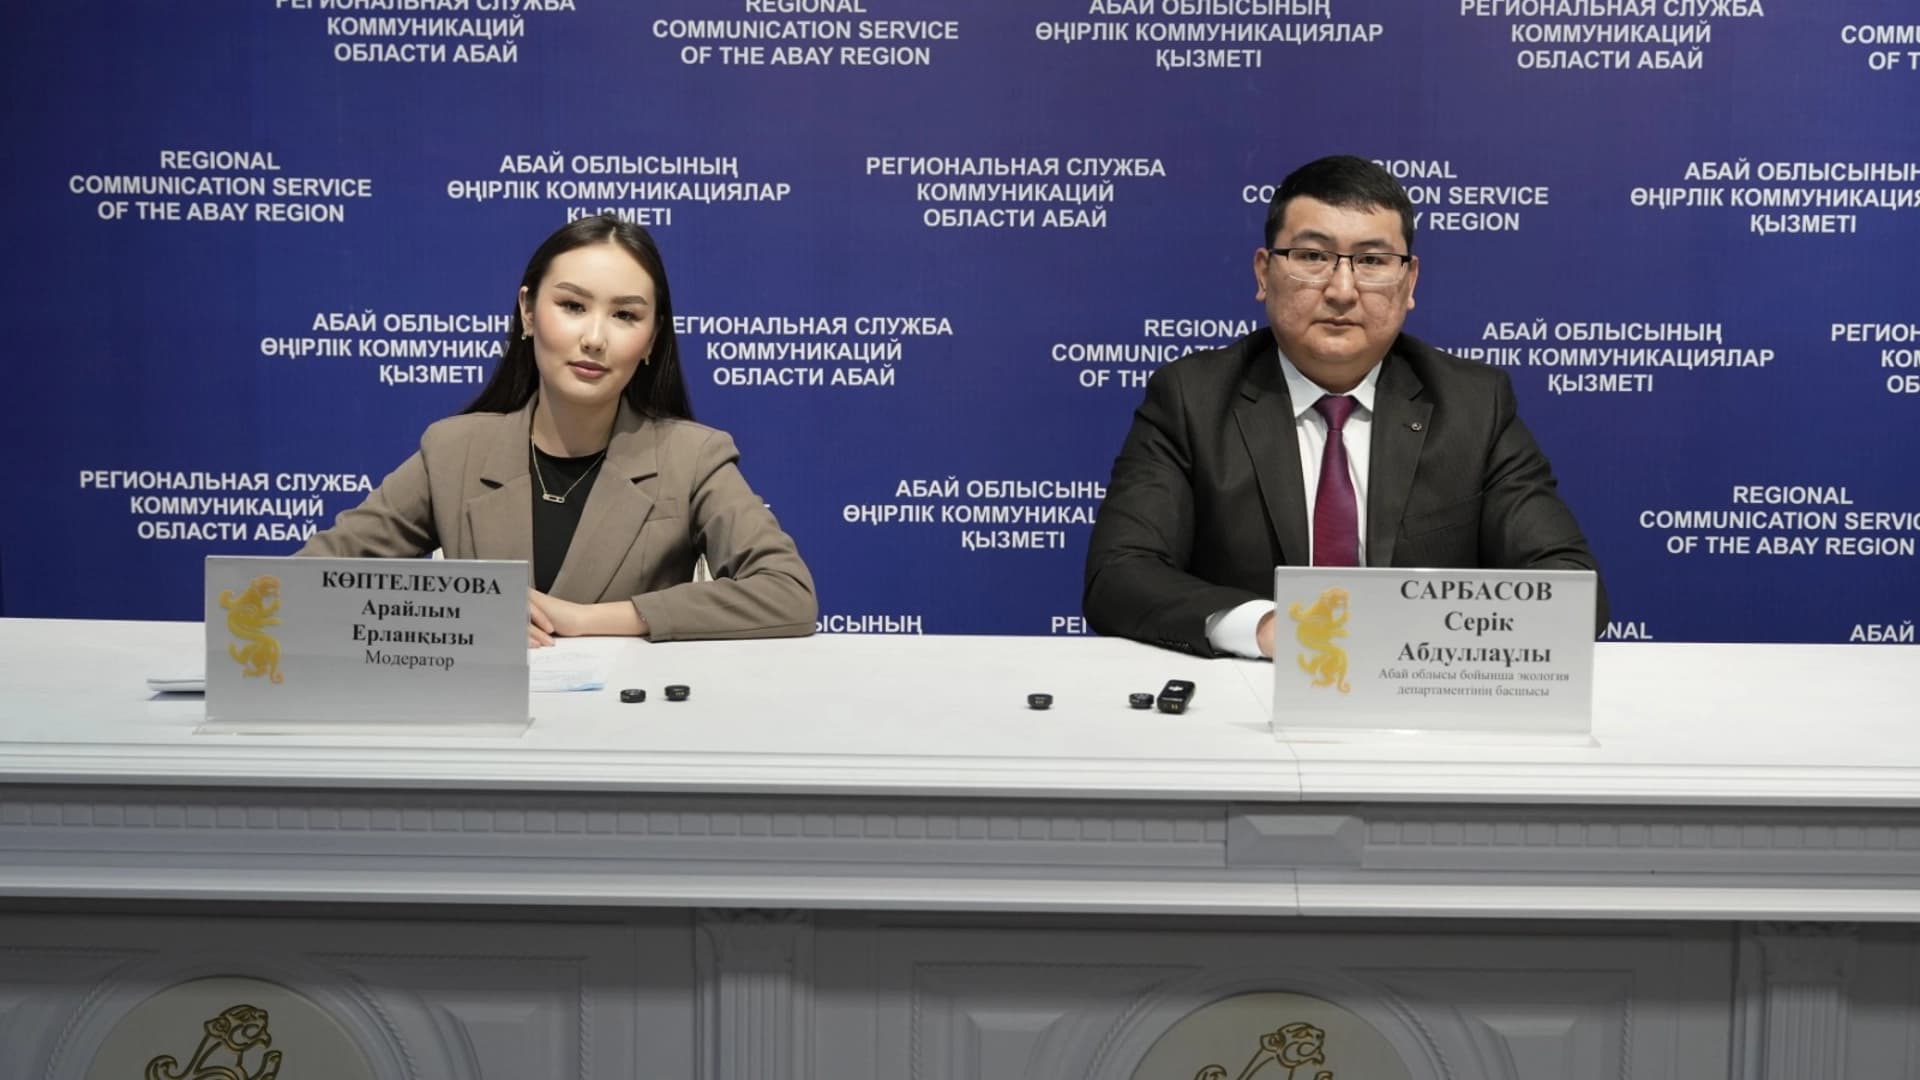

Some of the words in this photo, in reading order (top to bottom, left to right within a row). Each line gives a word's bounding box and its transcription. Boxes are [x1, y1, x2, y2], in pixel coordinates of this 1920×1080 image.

[1460, 0, 1657, 17] РЕГИОНАЛЬНАЯ
[1663, 0, 1765, 17] СЛУЖБА
[326, 13, 525, 41] КОММУНИКАЦИЙ
[652, 19, 851, 40] COMMUNICATION
[858, 20, 959, 40] SERVICE
[1035, 21, 1129, 44] ӨҢІРЛІК
[1135, 22, 1384, 46] КОММУНИКАЦИЯЛАР
[1511, 19, 1711, 47] КОММУНИКАЦИЙ
[1841, 24, 1920, 44] COMM
[334, 42, 446, 63] ОБЛАСТИ
[452, 39, 518, 63] АБАЙ
[680, 45, 713, 65] OF
[718, 46, 765, 65] THE
[770, 46, 834, 65] ABAY
[840, 46, 930, 66] REGION
[1156, 48, 1262, 71] ҚЫЗМЕТІ
[1517, 49, 1631, 69] ОБЛАСТИ
[1636, 46, 1703, 70] АБАЙ
[1868, 51, 1901, 71] OF
[160, 150, 281, 171] REGIONAL
[499, 150, 564, 174] АБАЙ
[571, 155, 739, 179] ОБЛЫСЫНЫҢ
[866, 156, 1059, 176] РЕГИОНАЛЬНАЯ
[1066, 157, 1166, 177] СЛУЖБА
[1371, 159, 1458, 179] IONAL
[1683, 157, 1751, 181] АБАЙ
[69, 175, 266, 196] COMMUNICATION
[272, 177, 372, 198] SERVICE
[447, 180, 541, 204] ӨҢІРЛІК
[546, 180, 791, 205] КОММУНИКАЦИЯЛАР
[917, 179, 1114, 206] КОММУНИКАЦИЙ
[1448, 186, 1549, 205] SERVICE
[1630, 187, 1725, 210] ӨҢІРЛІК
[97, 200, 129, 220] OF
[135, 201, 181, 221] THE
[186, 202, 249, 222] ABAY
[255, 203, 345, 223] REGION
[923, 208, 1035, 228] ОБЛАСТИ
[1041, 205, 1107, 228] АБАЙ
[1429, 211, 1520, 231] REGION
[1750, 213, 1857, 236] ҚЫЗМЕТІ
[312, 309, 377, 332] АБАЙ
[383, 313, 512, 333] ОБЛЫСЫН
[672, 315, 848, 335] ЕГИОНАЛЬНАЯ
[854, 316, 954, 336] СЛУЖБА
[1481, 318, 1548, 341] АБАЙ
[1554, 322, 1723, 345] ОБЛЫСЫНЫҢ
[260, 337, 353, 360] ӨҢІРЛІК
[358, 338, 506, 359] КОММУНИКА
[706, 337, 902, 364] КОММУНИКАЦИЙ
[1528, 347, 1775, 371] КОММУНИКАЦИЯЛАР
[379, 364, 484, 386] ҚЫЗМЕТІ
[713, 367, 824, 386] ОБЛАСТИ
[830, 363, 895, 386] АБАЙ
[1079, 368, 1111, 388] OF
[1116, 369, 1155, 388] TH
[1548, 373, 1653, 396] ҚЫЗМЕТІ
[80, 470, 270, 491] РЕГИОНАЛЬНАЯ
[275, 472, 374, 492] СЛУЖБА
[895, 475, 960, 498] АБАЙ
[1733, 485, 1854, 505] REGIONAL
[130, 494, 324, 520] КОММУНИКАЦИЙ
[842, 504, 935, 526] ӨҢІРЛІК
[137, 521, 247, 541] ОБЛАСТИ
[1639, 510, 1838, 530] COMMUNICATION
[961, 530, 1065, 552] ҚЫЗМЕТІ
[1666, 535, 1699, 554] OF
[1704, 535, 1751, 554] THE
[1755, 536, 1820, 555] ABAY
[1825, 537, 1915, 556] REGION
[322, 570, 502, 595] КӨПТЕЛЕУОВА
[1400, 579, 1553, 602] САРБАСОВ
[361, 599, 461, 621] Арайлым
[352, 623, 474, 647] Ерланқызы
[1444, 611, 1514, 636] Серік
[1849, 620, 1915, 643] АБАЙ
[365, 649, 455, 671] Модератор
[1378, 667, 1409, 680] Абай
